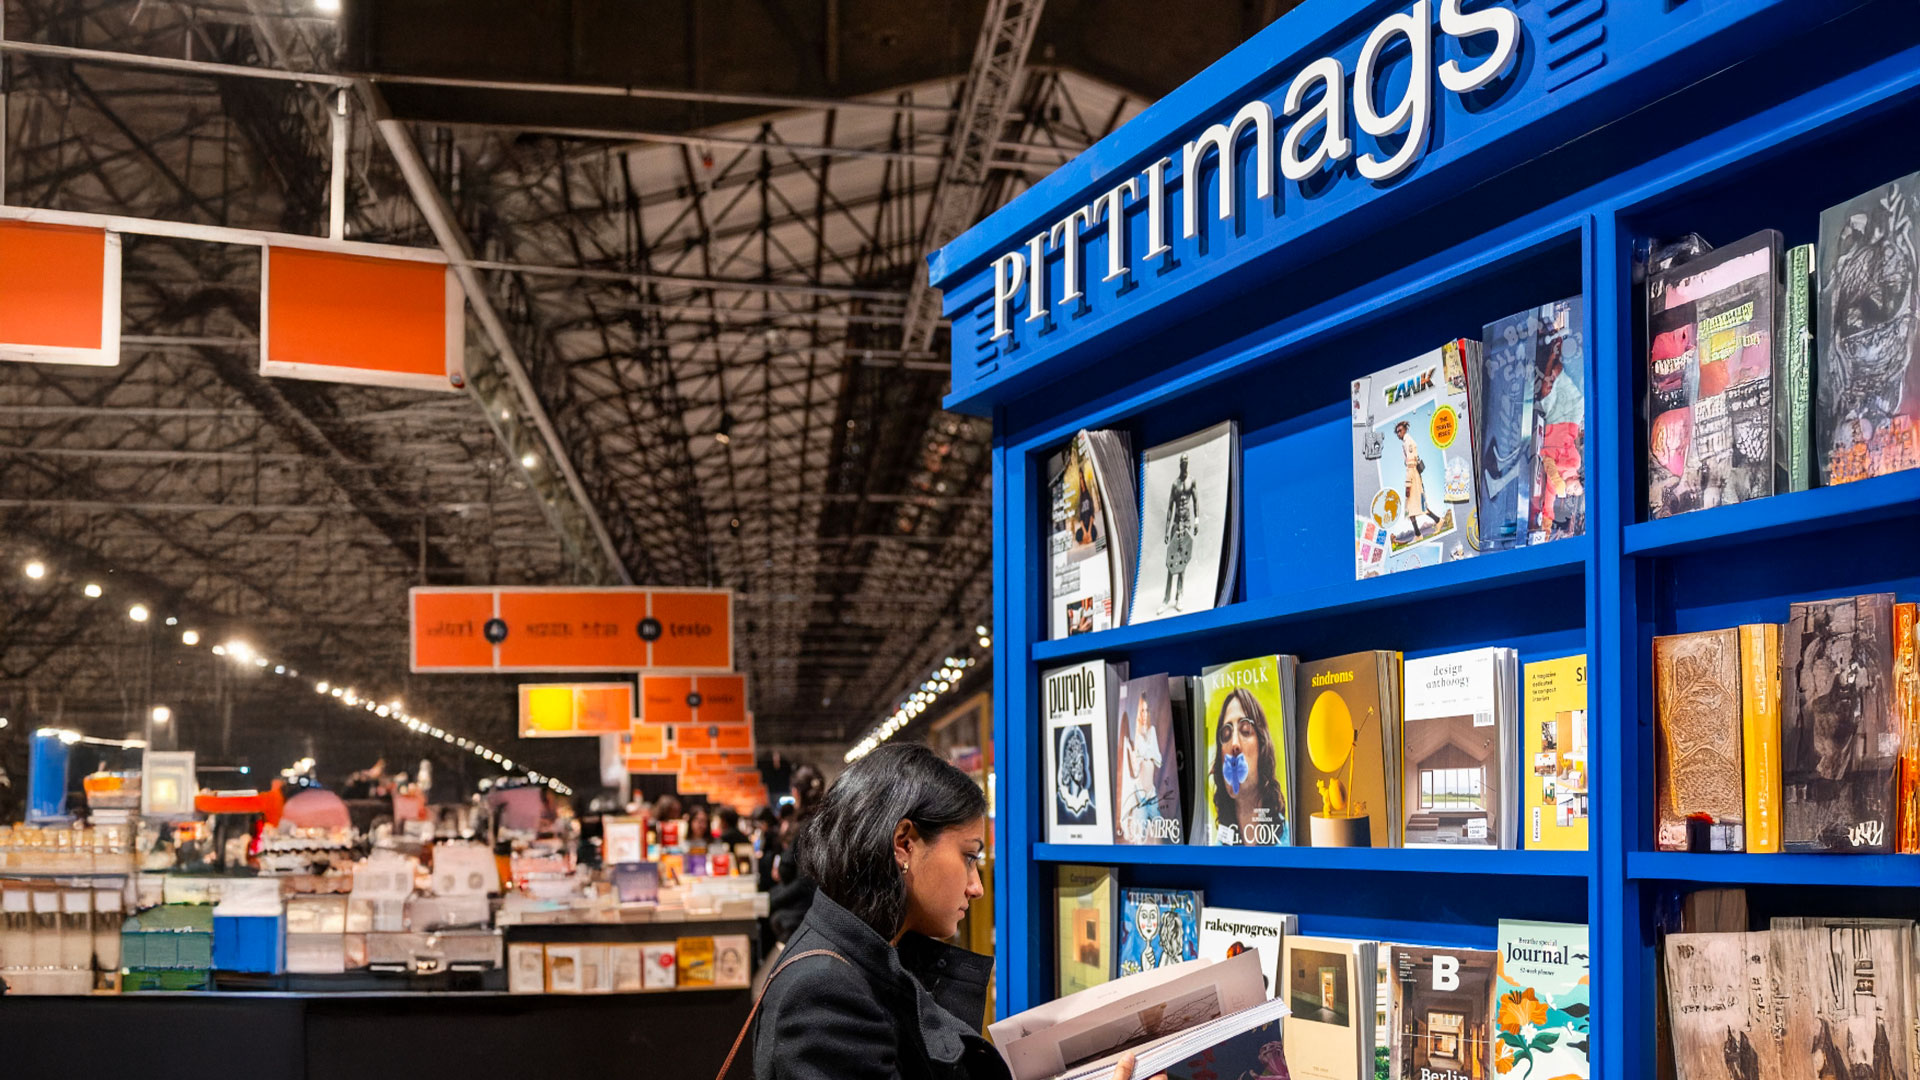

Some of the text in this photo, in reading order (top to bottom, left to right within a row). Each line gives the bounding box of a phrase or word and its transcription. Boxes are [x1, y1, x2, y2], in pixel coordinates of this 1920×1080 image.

[1384, 365, 1436, 407] TANK
[1212, 666, 1269, 689] KINFOLK
[1311, 670, 1354, 688] sindroms
[1433, 664, 1463, 677] design
[1049, 666, 1095, 719] purple
[1425, 676, 1470, 689] anthology
[1243, 823, 1282, 845] COOK
[1128, 891, 1186, 909] THE PLANT
[1205, 918, 1279, 938] rakesprogress
[1518, 937, 1558, 947] Breathe special
[1506, 942, 1569, 965] Journal
[1432, 954, 1460, 992] B
